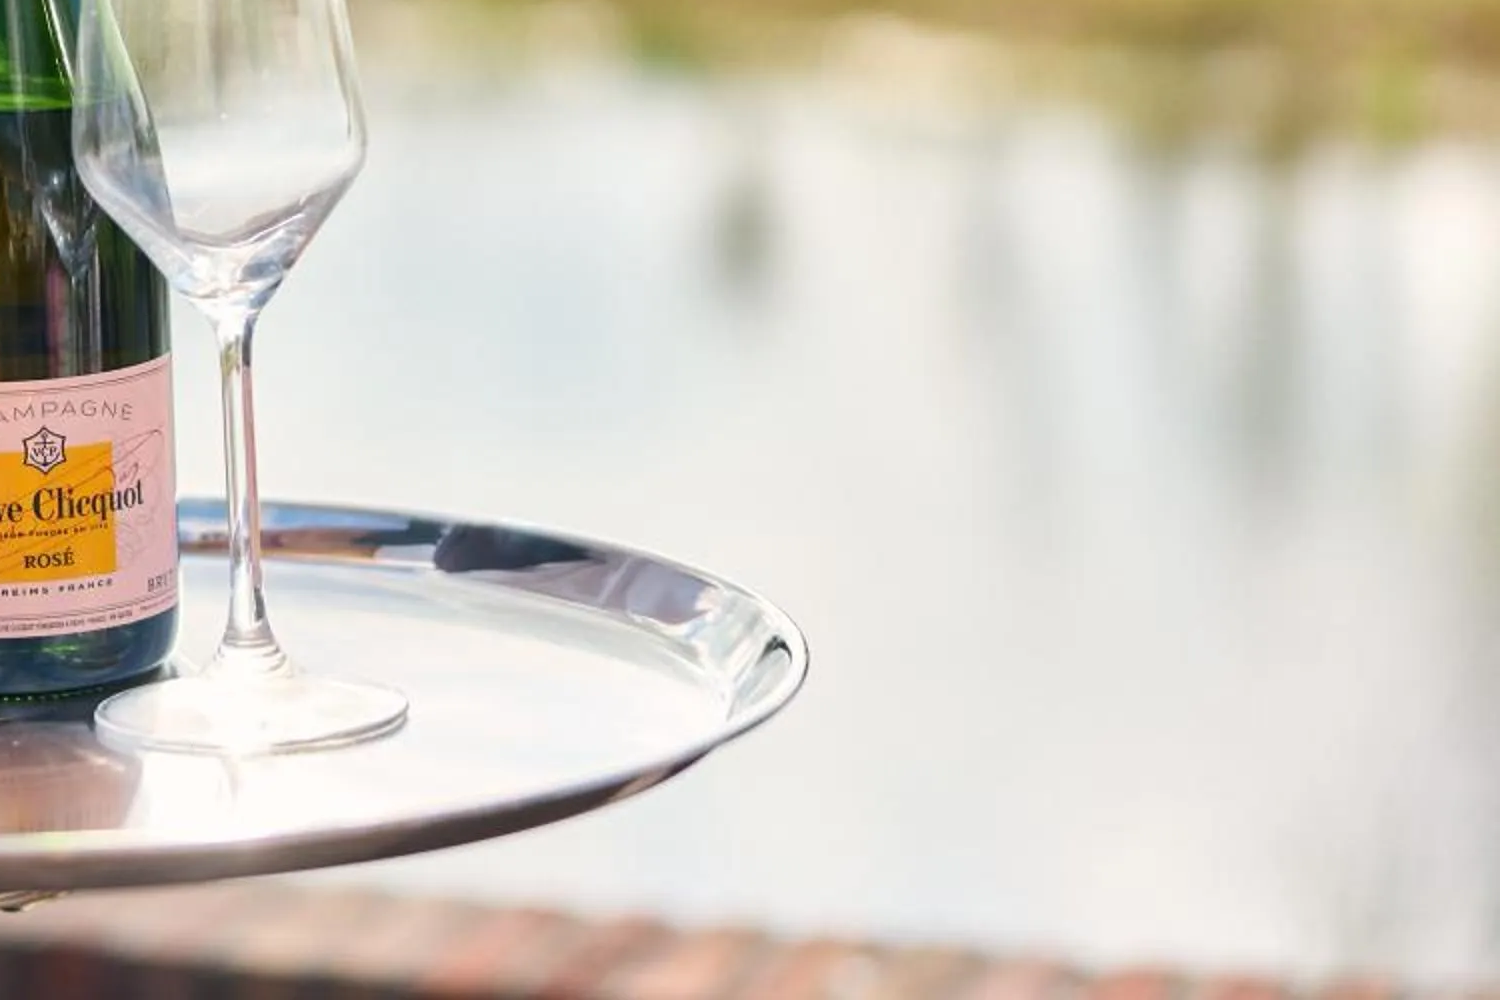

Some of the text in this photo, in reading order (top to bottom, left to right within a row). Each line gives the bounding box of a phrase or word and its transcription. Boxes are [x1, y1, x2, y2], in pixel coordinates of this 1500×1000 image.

[32, 479, 144, 522] Clicquot
[23, 545, 76, 569] ROSÉ
[58, 578, 113, 592] FRANCE
